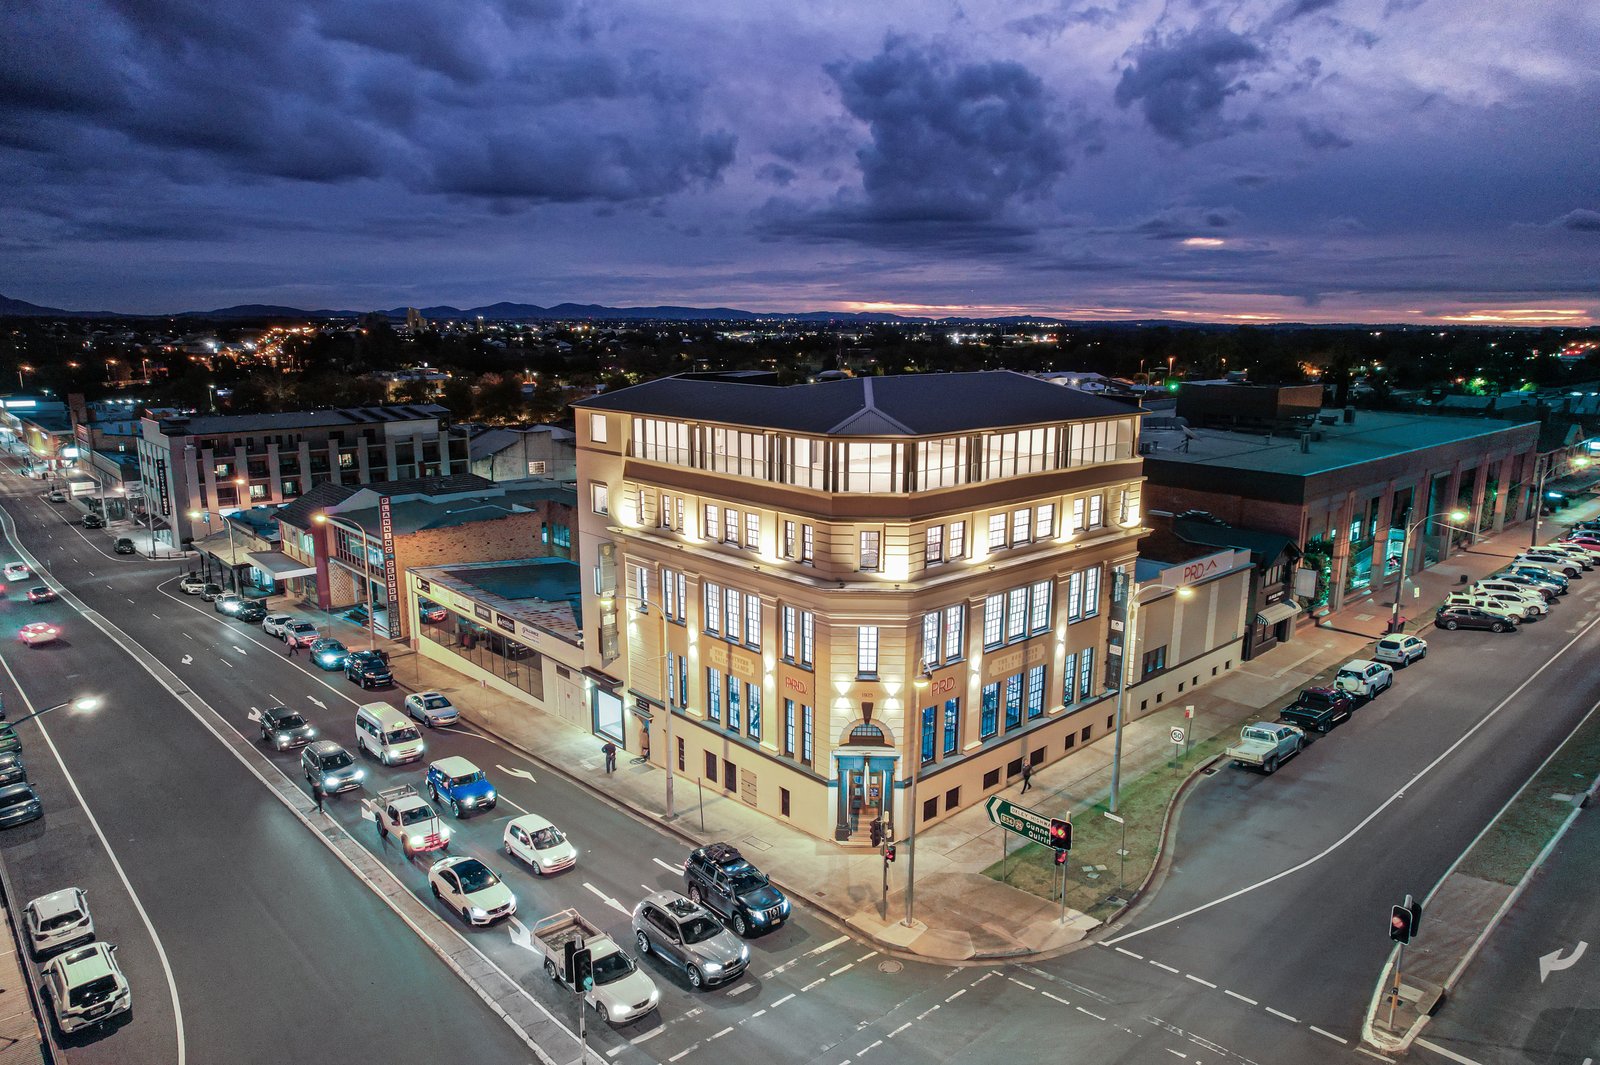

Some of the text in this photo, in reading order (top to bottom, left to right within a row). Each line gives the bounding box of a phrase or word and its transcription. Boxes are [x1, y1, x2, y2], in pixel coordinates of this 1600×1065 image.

[382, 498, 393, 553] PLANNING
[386, 560, 397, 601] CENTRE
[1011, 807, 1051, 827] OXLEY HIGHWA
[1025, 821, 1051, 838] Gunne
[1028, 830, 1051, 846] Quirin
